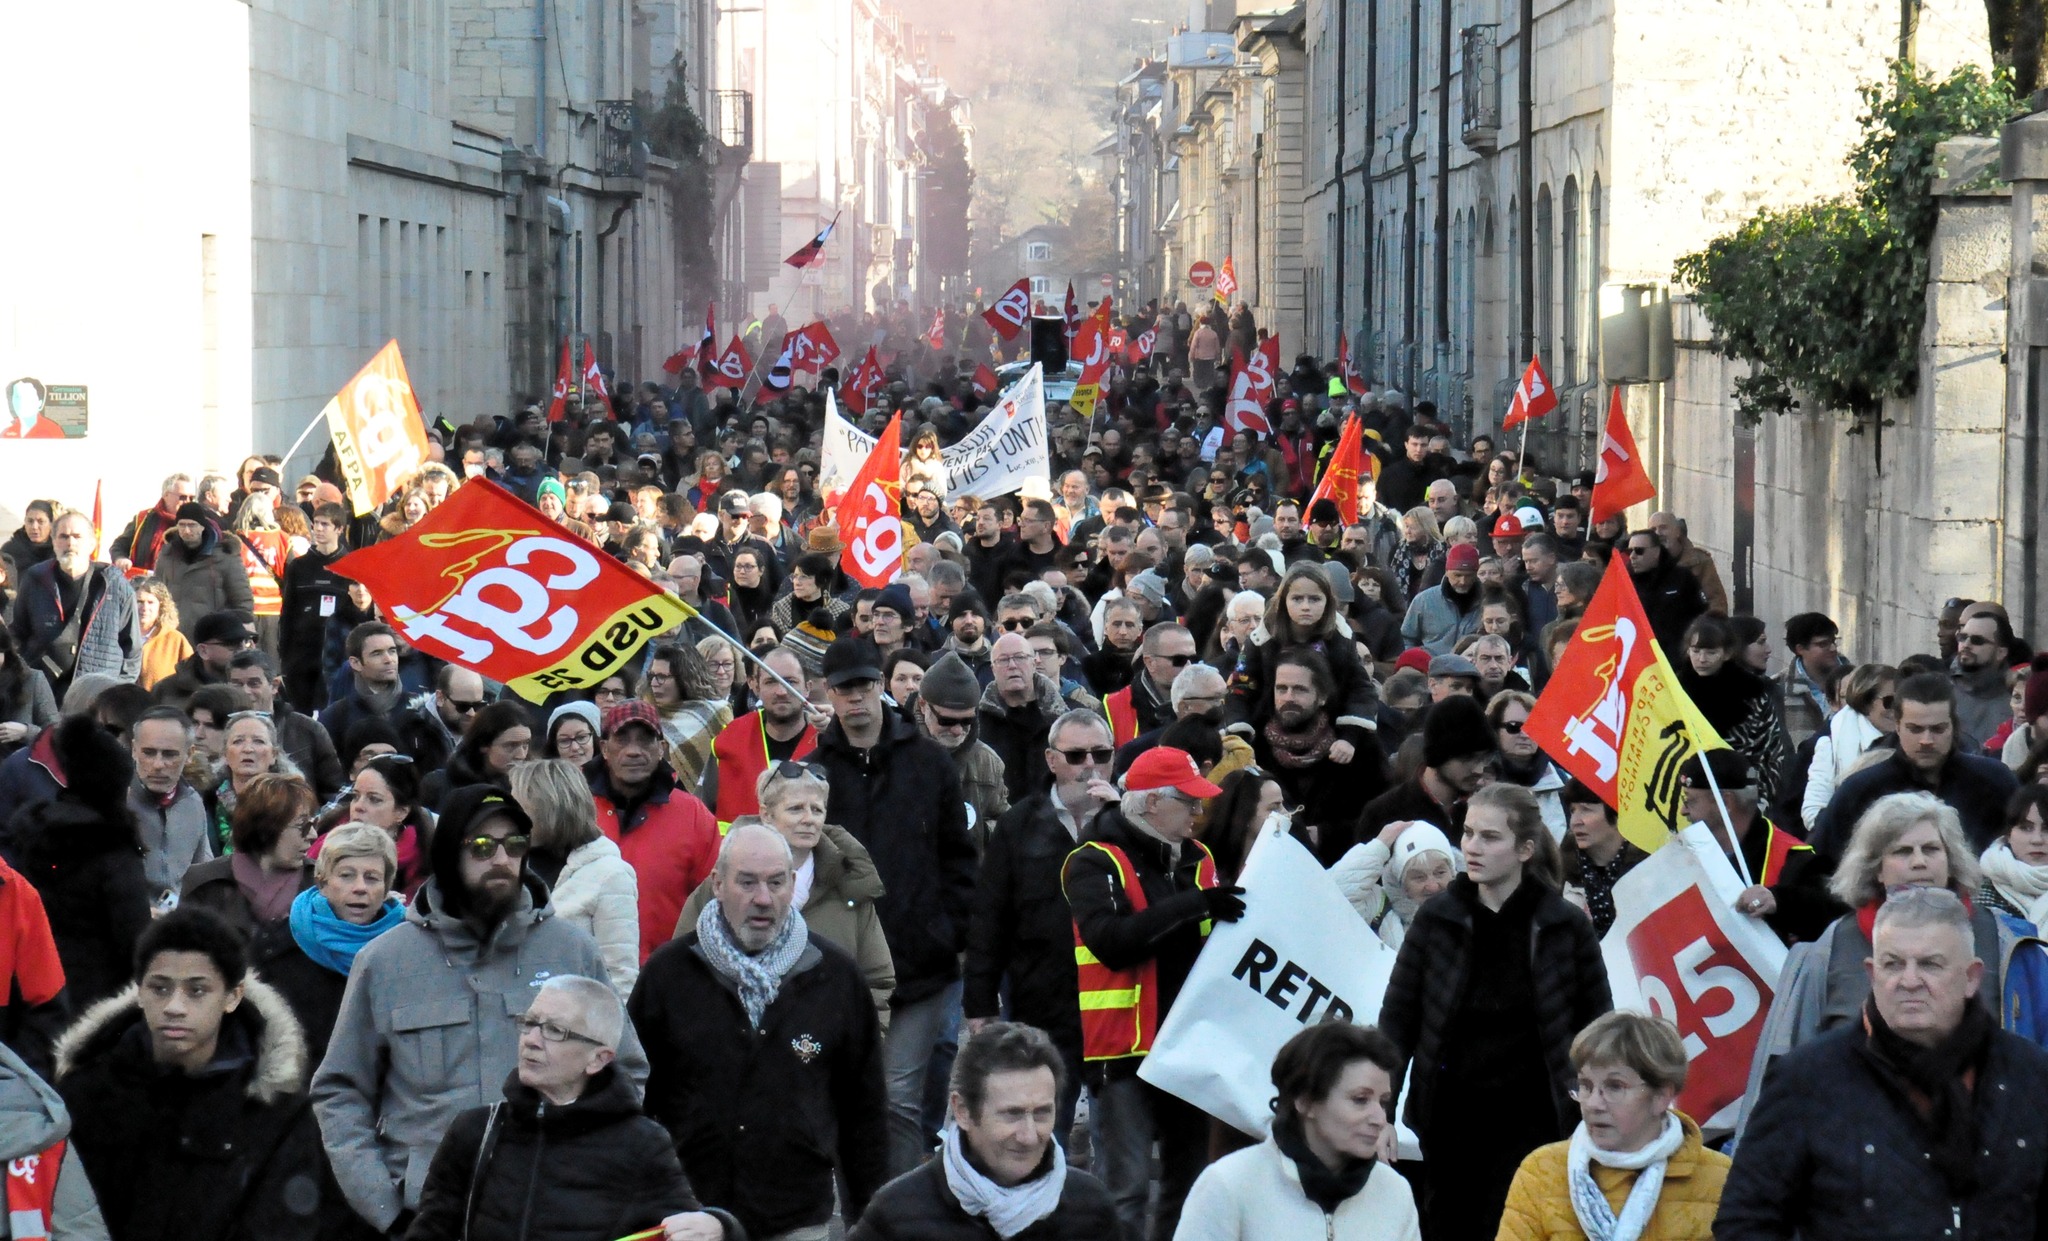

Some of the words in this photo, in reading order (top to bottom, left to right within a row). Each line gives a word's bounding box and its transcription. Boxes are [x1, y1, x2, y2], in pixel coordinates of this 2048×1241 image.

[1110, 336, 1122, 347] FO
[49, 392, 87, 401] TILLION
[334, 430, 364, 492] AFPA
